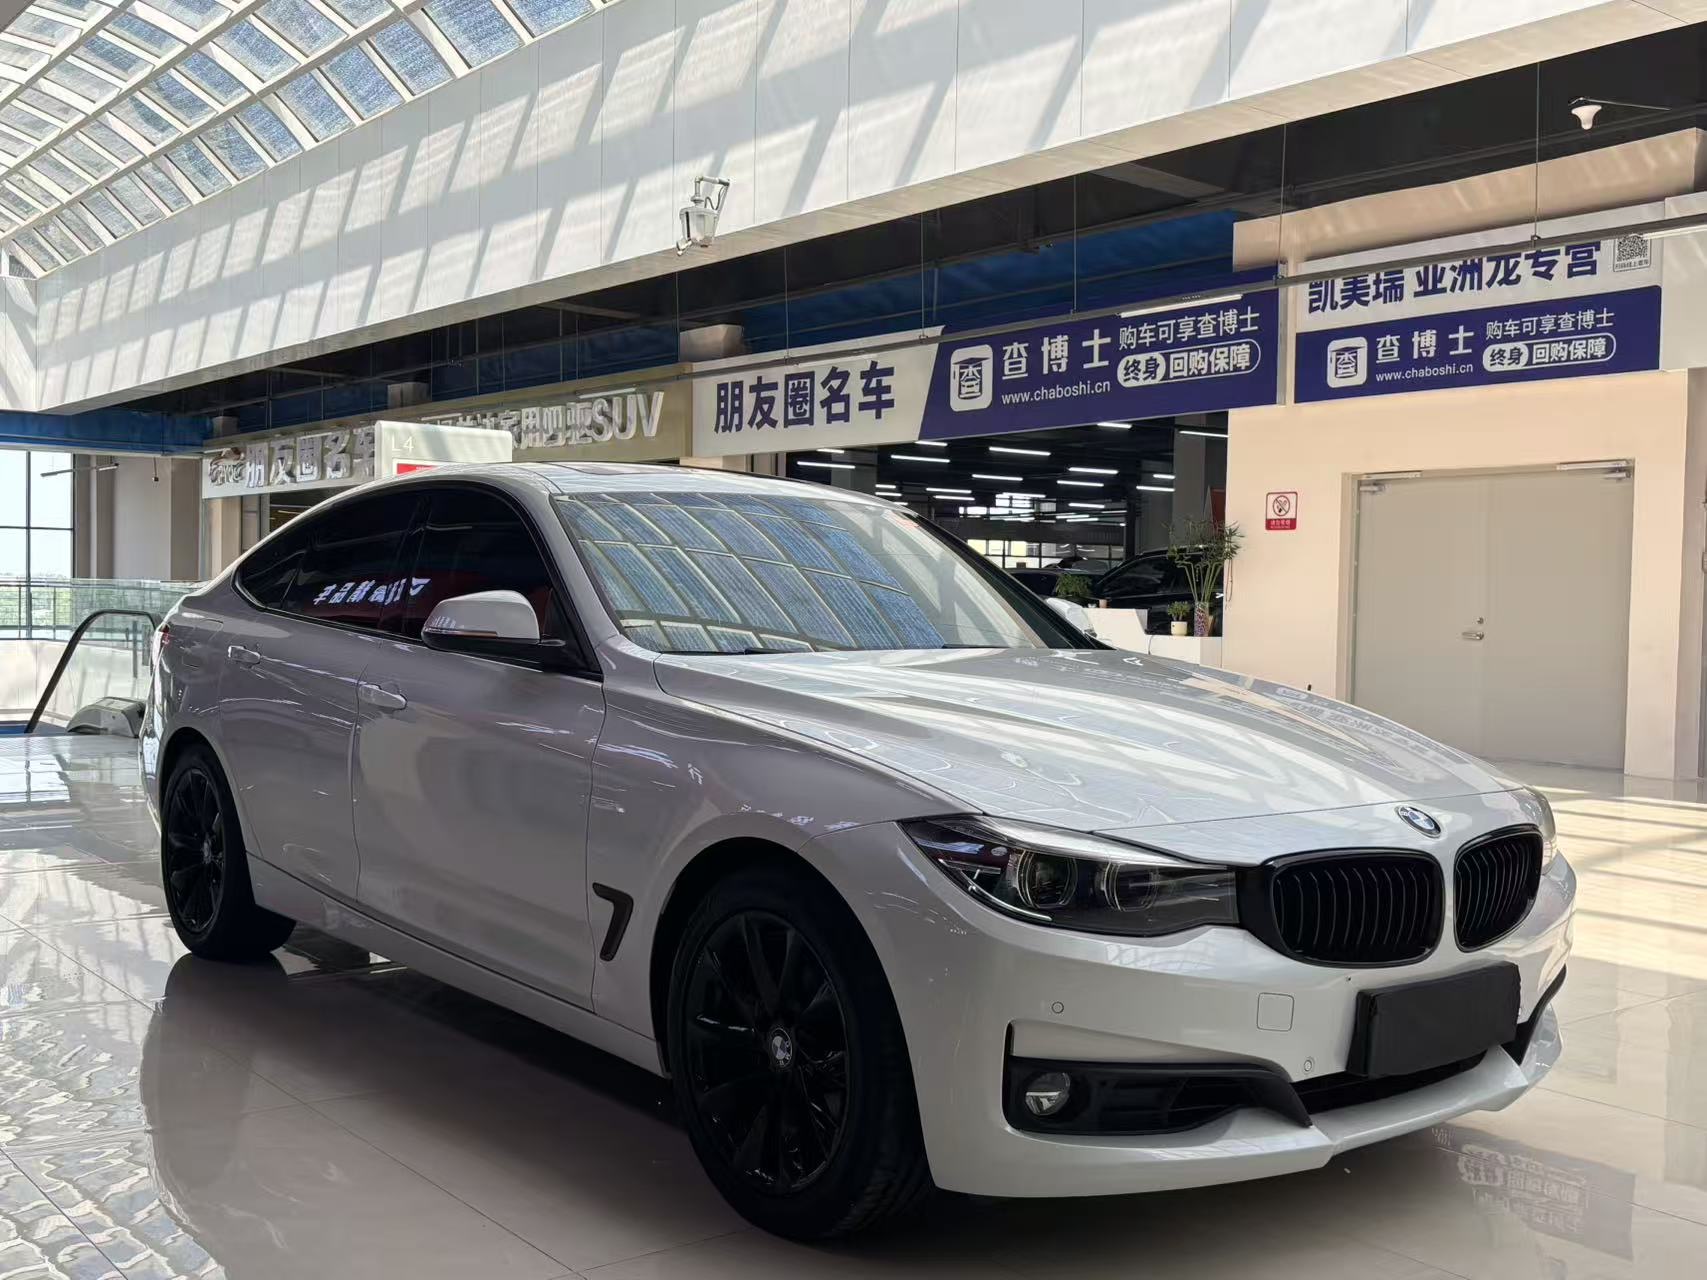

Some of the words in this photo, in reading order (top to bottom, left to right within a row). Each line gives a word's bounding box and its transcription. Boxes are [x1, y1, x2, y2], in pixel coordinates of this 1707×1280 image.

[1119, 306, 1260, 350] 购车可享查博士
[1485, 307, 1615, 340] 购车可享查博士
[1002, 329, 1112, 380] 查博士
[1376, 325, 1475, 363] 查博士
[1375, 363, 1474, 382] www.chaboshi.cn
[714, 360, 895, 434] 朋友圈名车
[1001, 381, 1111, 405] www.chaboshi.cn
[391, 435, 415, 454] L4
